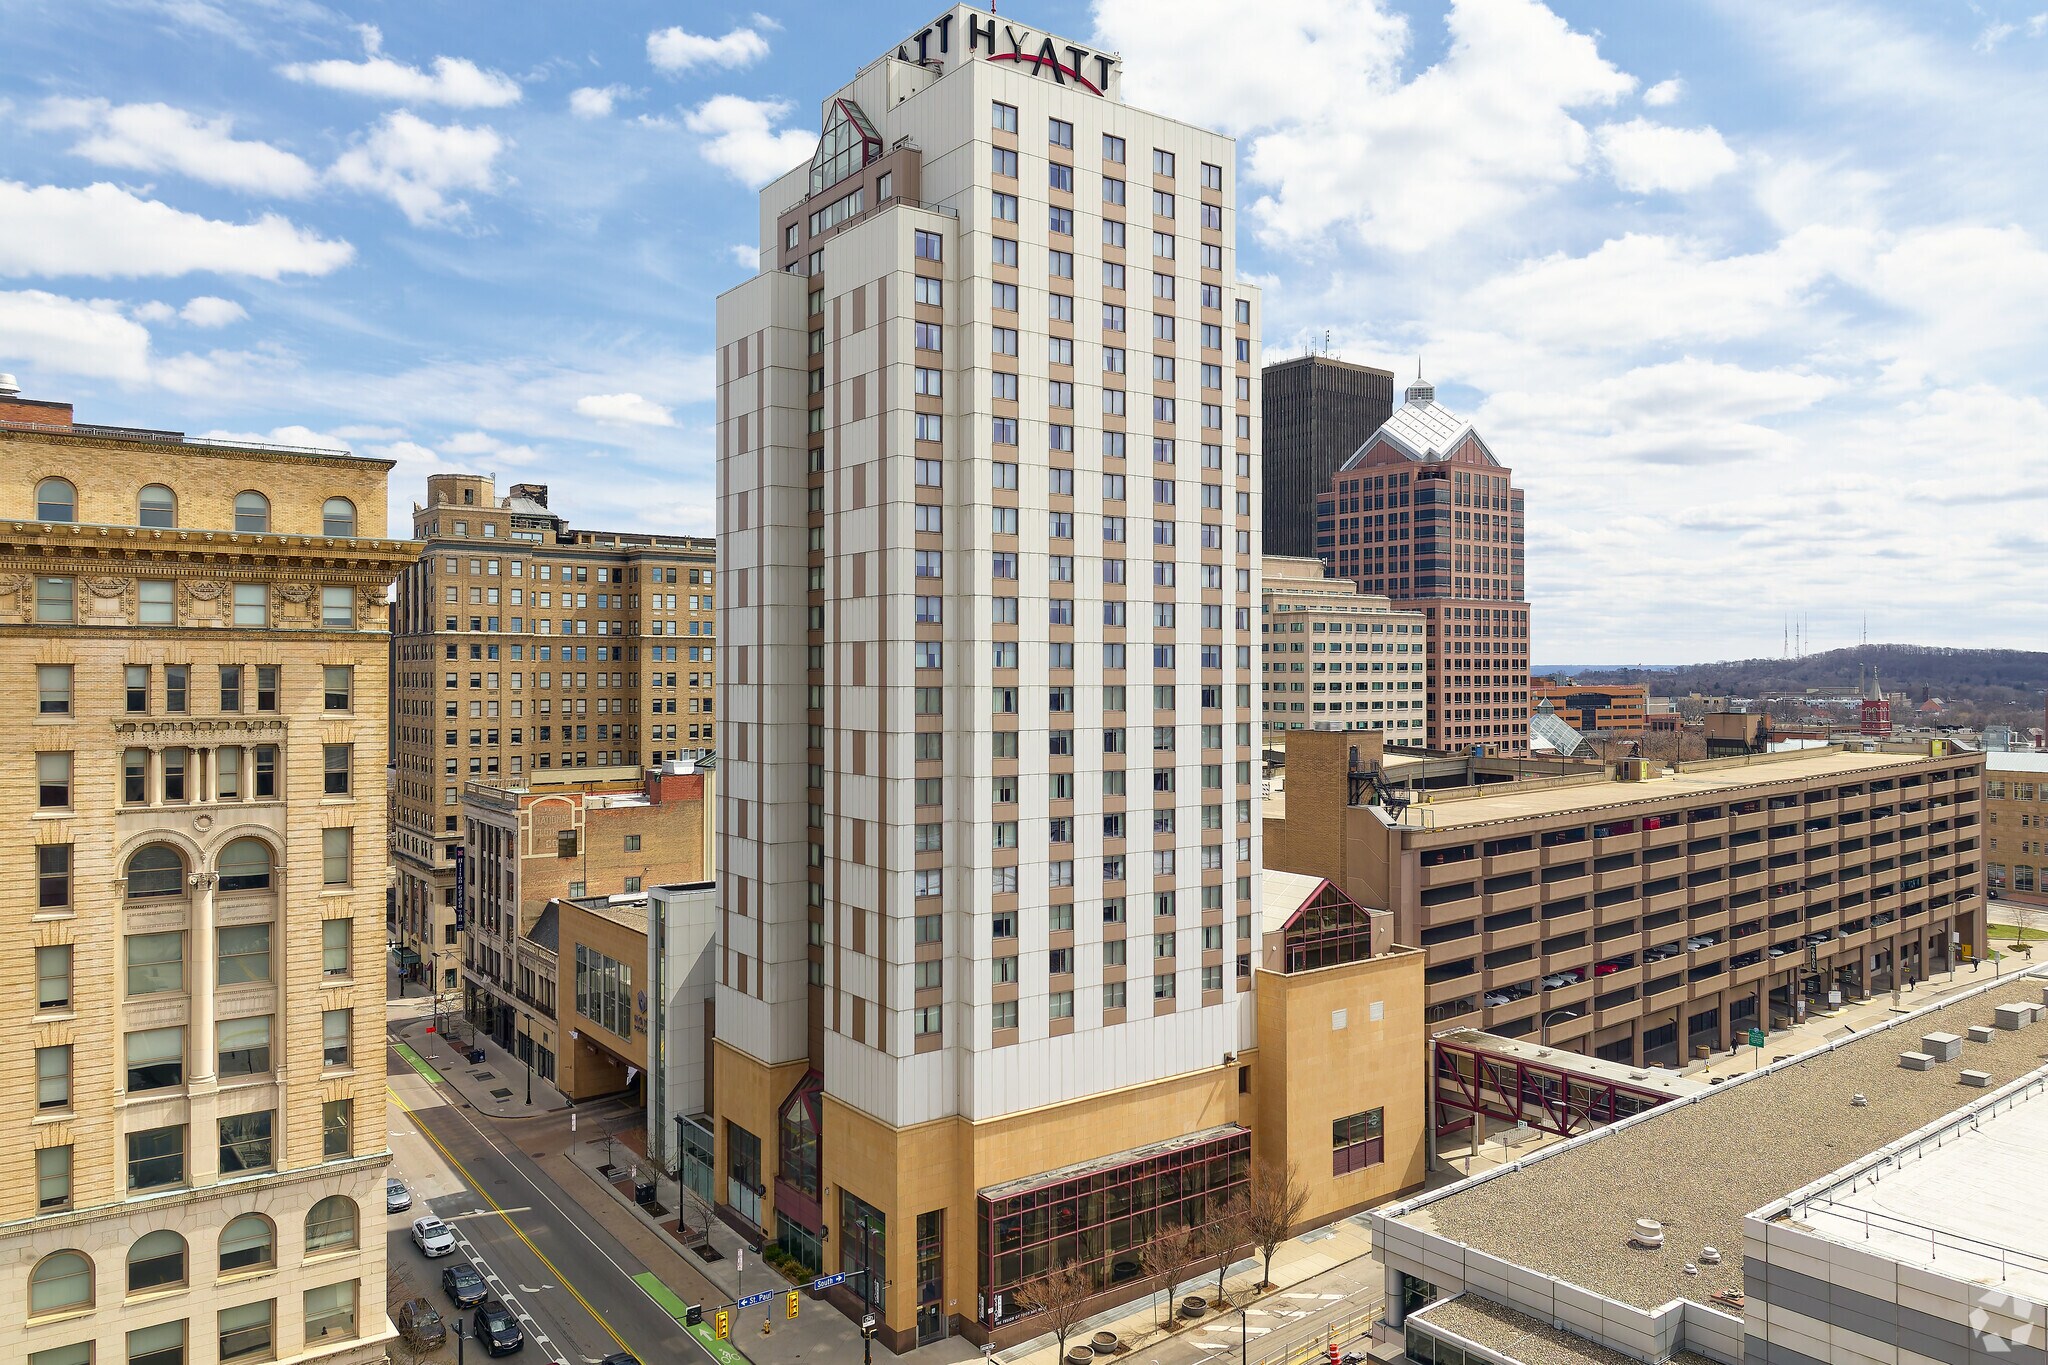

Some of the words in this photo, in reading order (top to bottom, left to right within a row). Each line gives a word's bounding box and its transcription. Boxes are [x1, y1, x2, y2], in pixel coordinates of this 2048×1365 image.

[970, 13, 1115, 90] HYATT
[817, 1278, 834, 1288] South
[749, 1296, 758, 1304] St.
[758, 1291, 772, 1302] Paul
